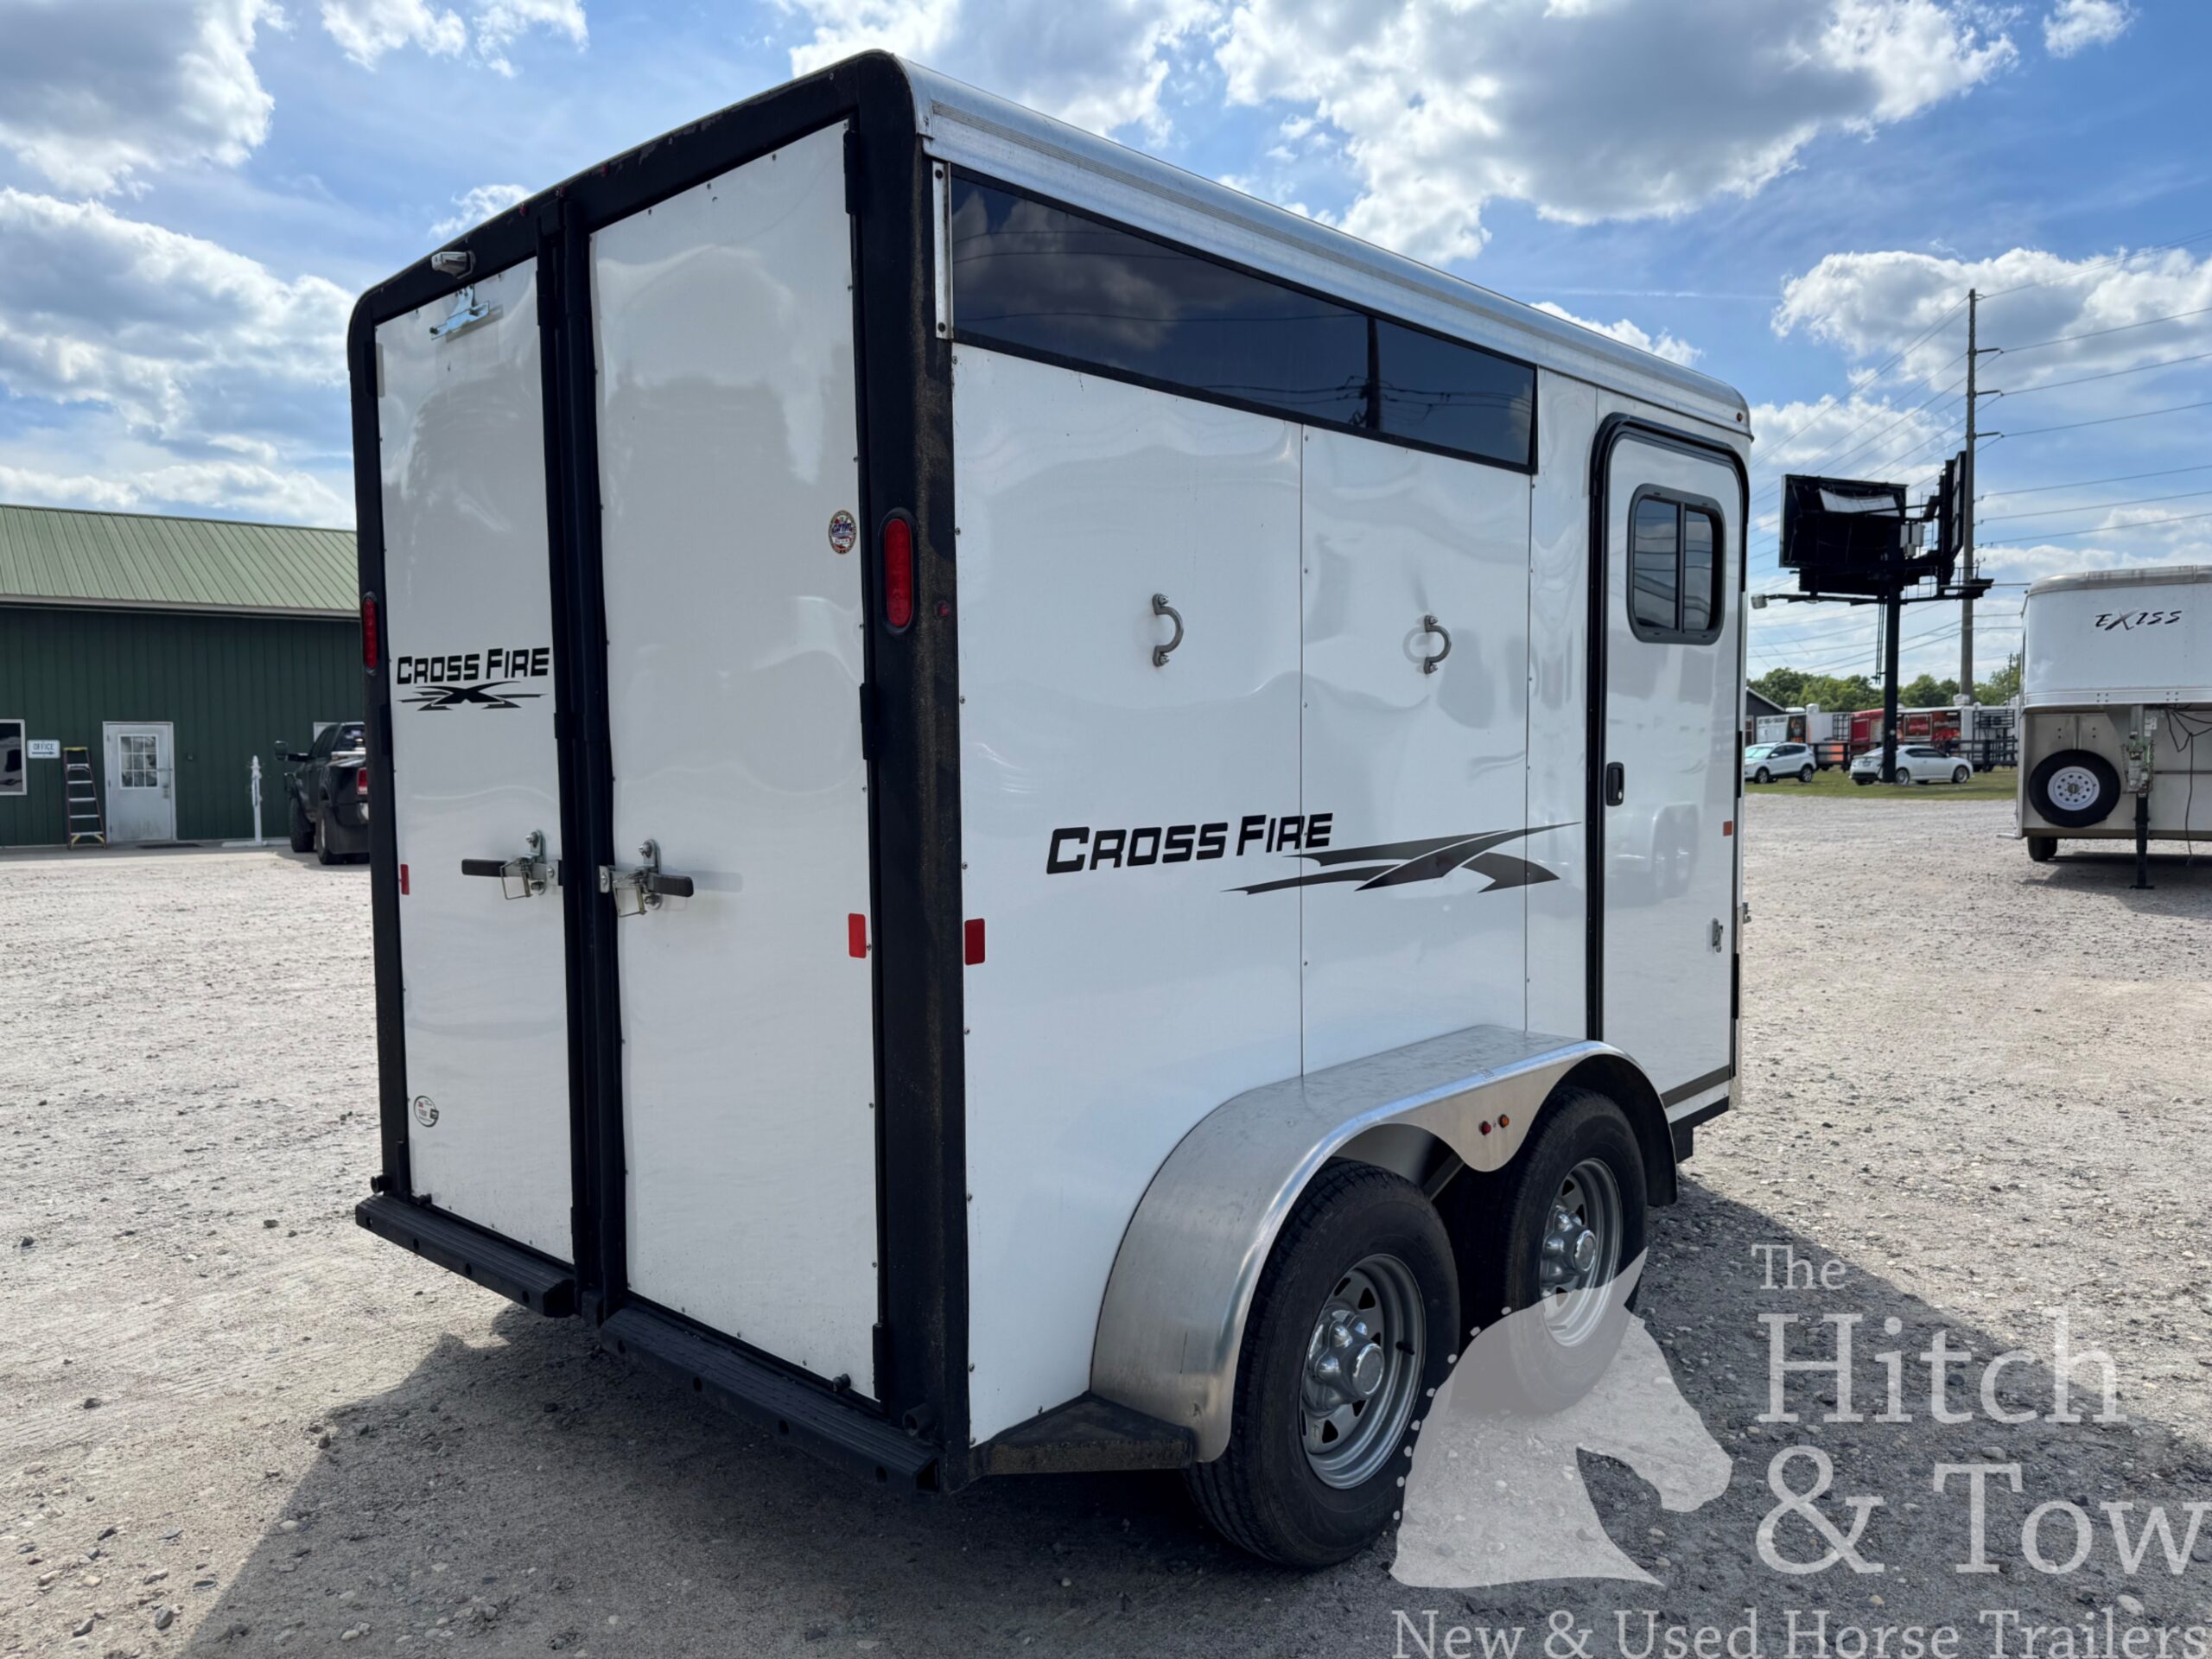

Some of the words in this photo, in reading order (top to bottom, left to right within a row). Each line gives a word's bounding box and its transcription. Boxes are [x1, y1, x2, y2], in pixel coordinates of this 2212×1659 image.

[2095, 607, 2183, 631] EXISS
[397, 653, 480, 684] CROSS
[486, 647, 550, 679] FIRE
[1046, 822, 1229, 874] CROSS
[1236, 812, 1333, 856] FIRE
